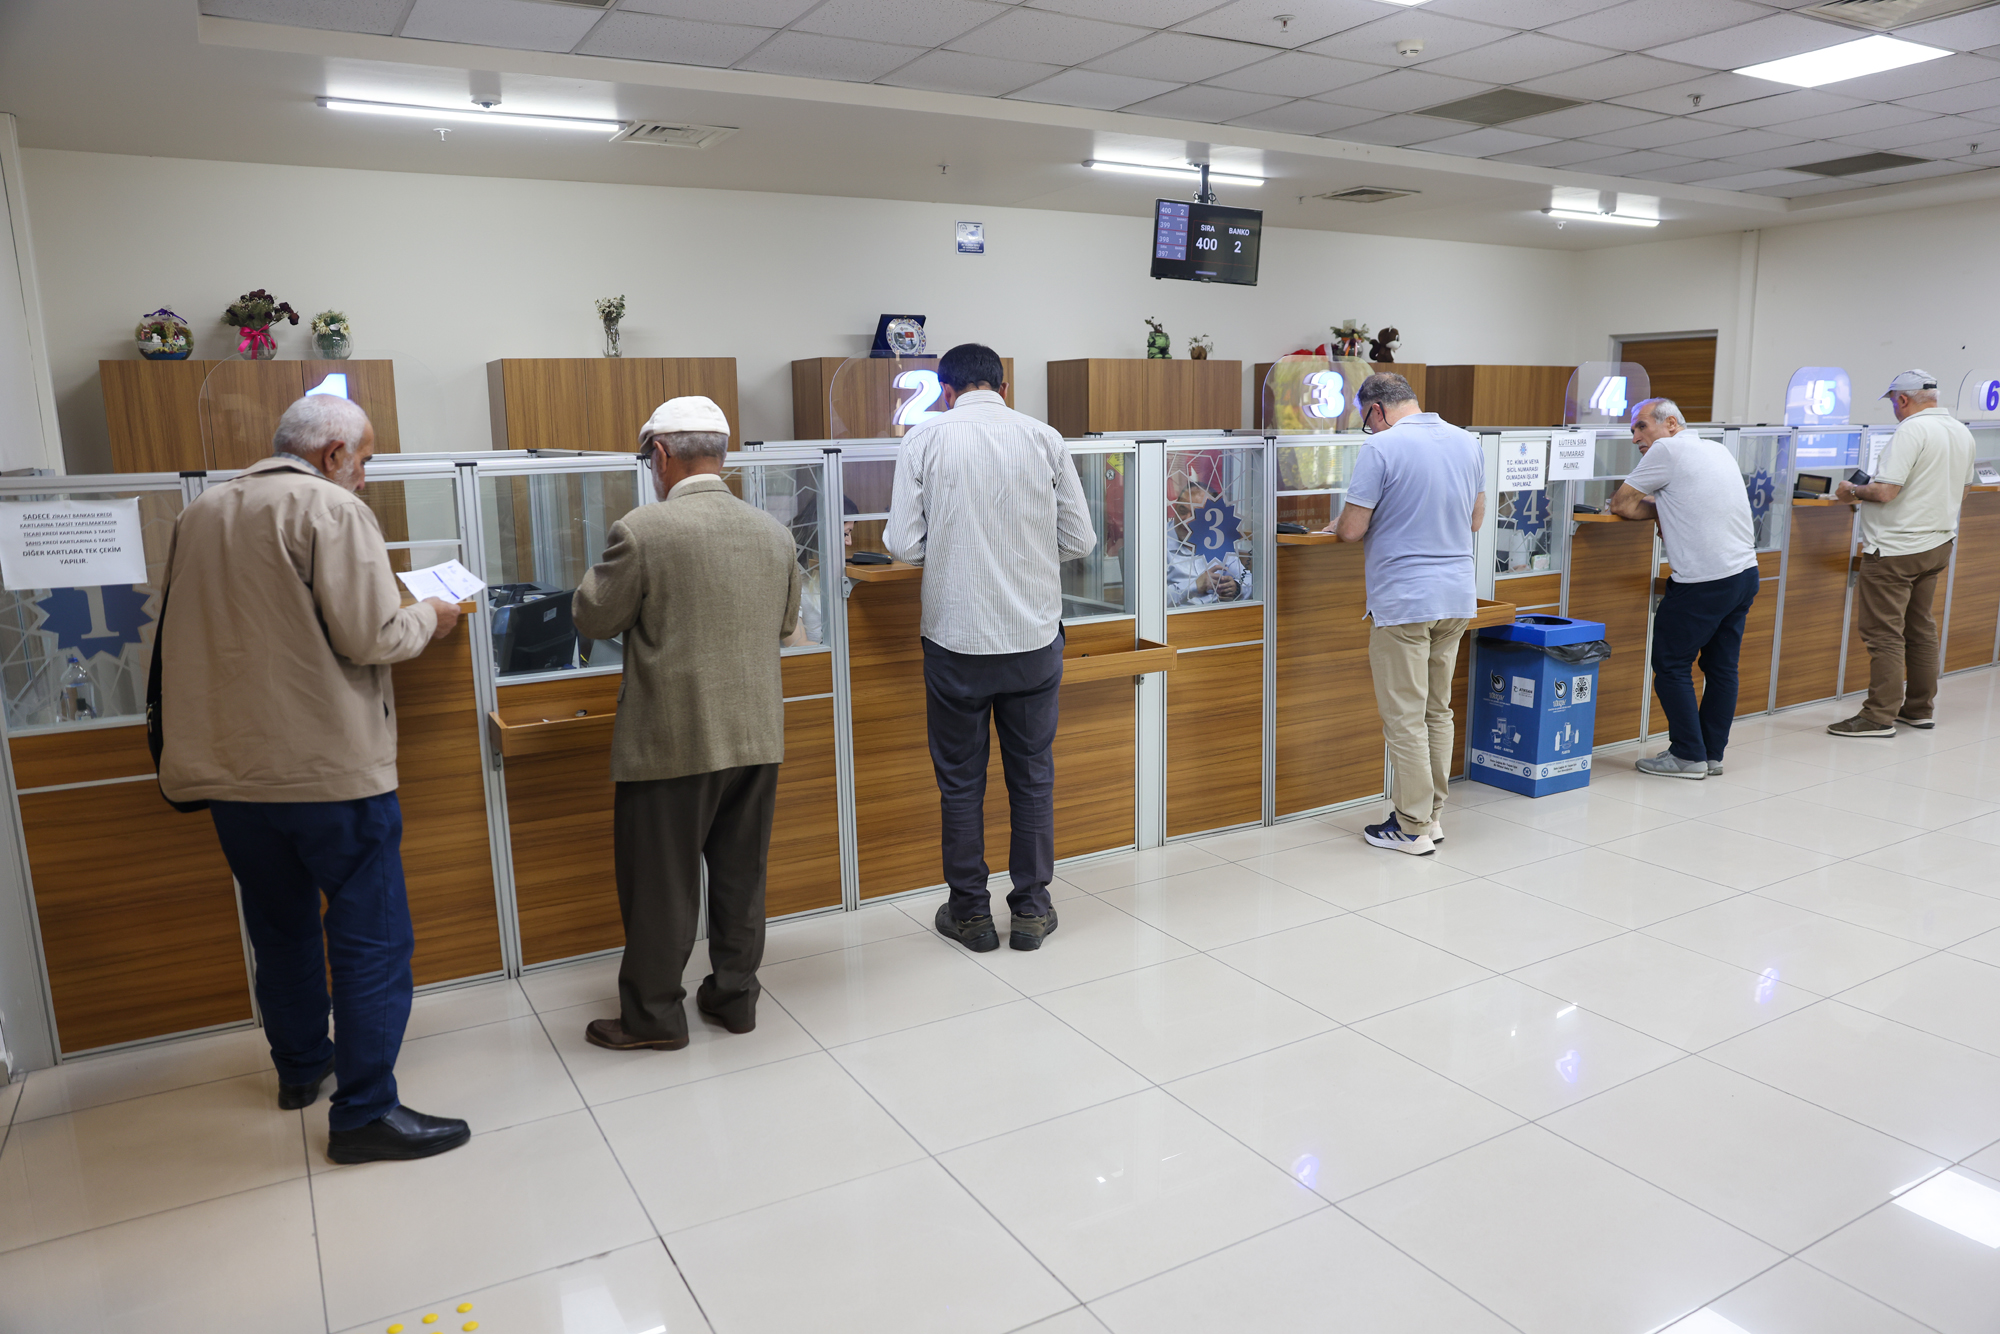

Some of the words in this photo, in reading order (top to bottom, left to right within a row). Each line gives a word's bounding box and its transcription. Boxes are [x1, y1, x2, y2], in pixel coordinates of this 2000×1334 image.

[1196, 237, 1218, 251] 400
[1234, 240, 1242, 253] 2
[1200, 224, 1215, 232] SIRA
[1228, 227, 1250, 236] BANKO
[896, 370, 944, 425] 2
[1309, 371, 1346, 418] 3
[1596, 376, 1628, 416] 4
[1811, 380, 1836, 416] 5
[1985, 380, 2000, 411] 6
[1523, 490, 1540, 524] 4
[1753, 477, 1768, 509] 5
[1204, 508, 1225, 550] 3
[99, 546, 122, 554] ÇEKİM
[73, 586, 120, 639] 1
